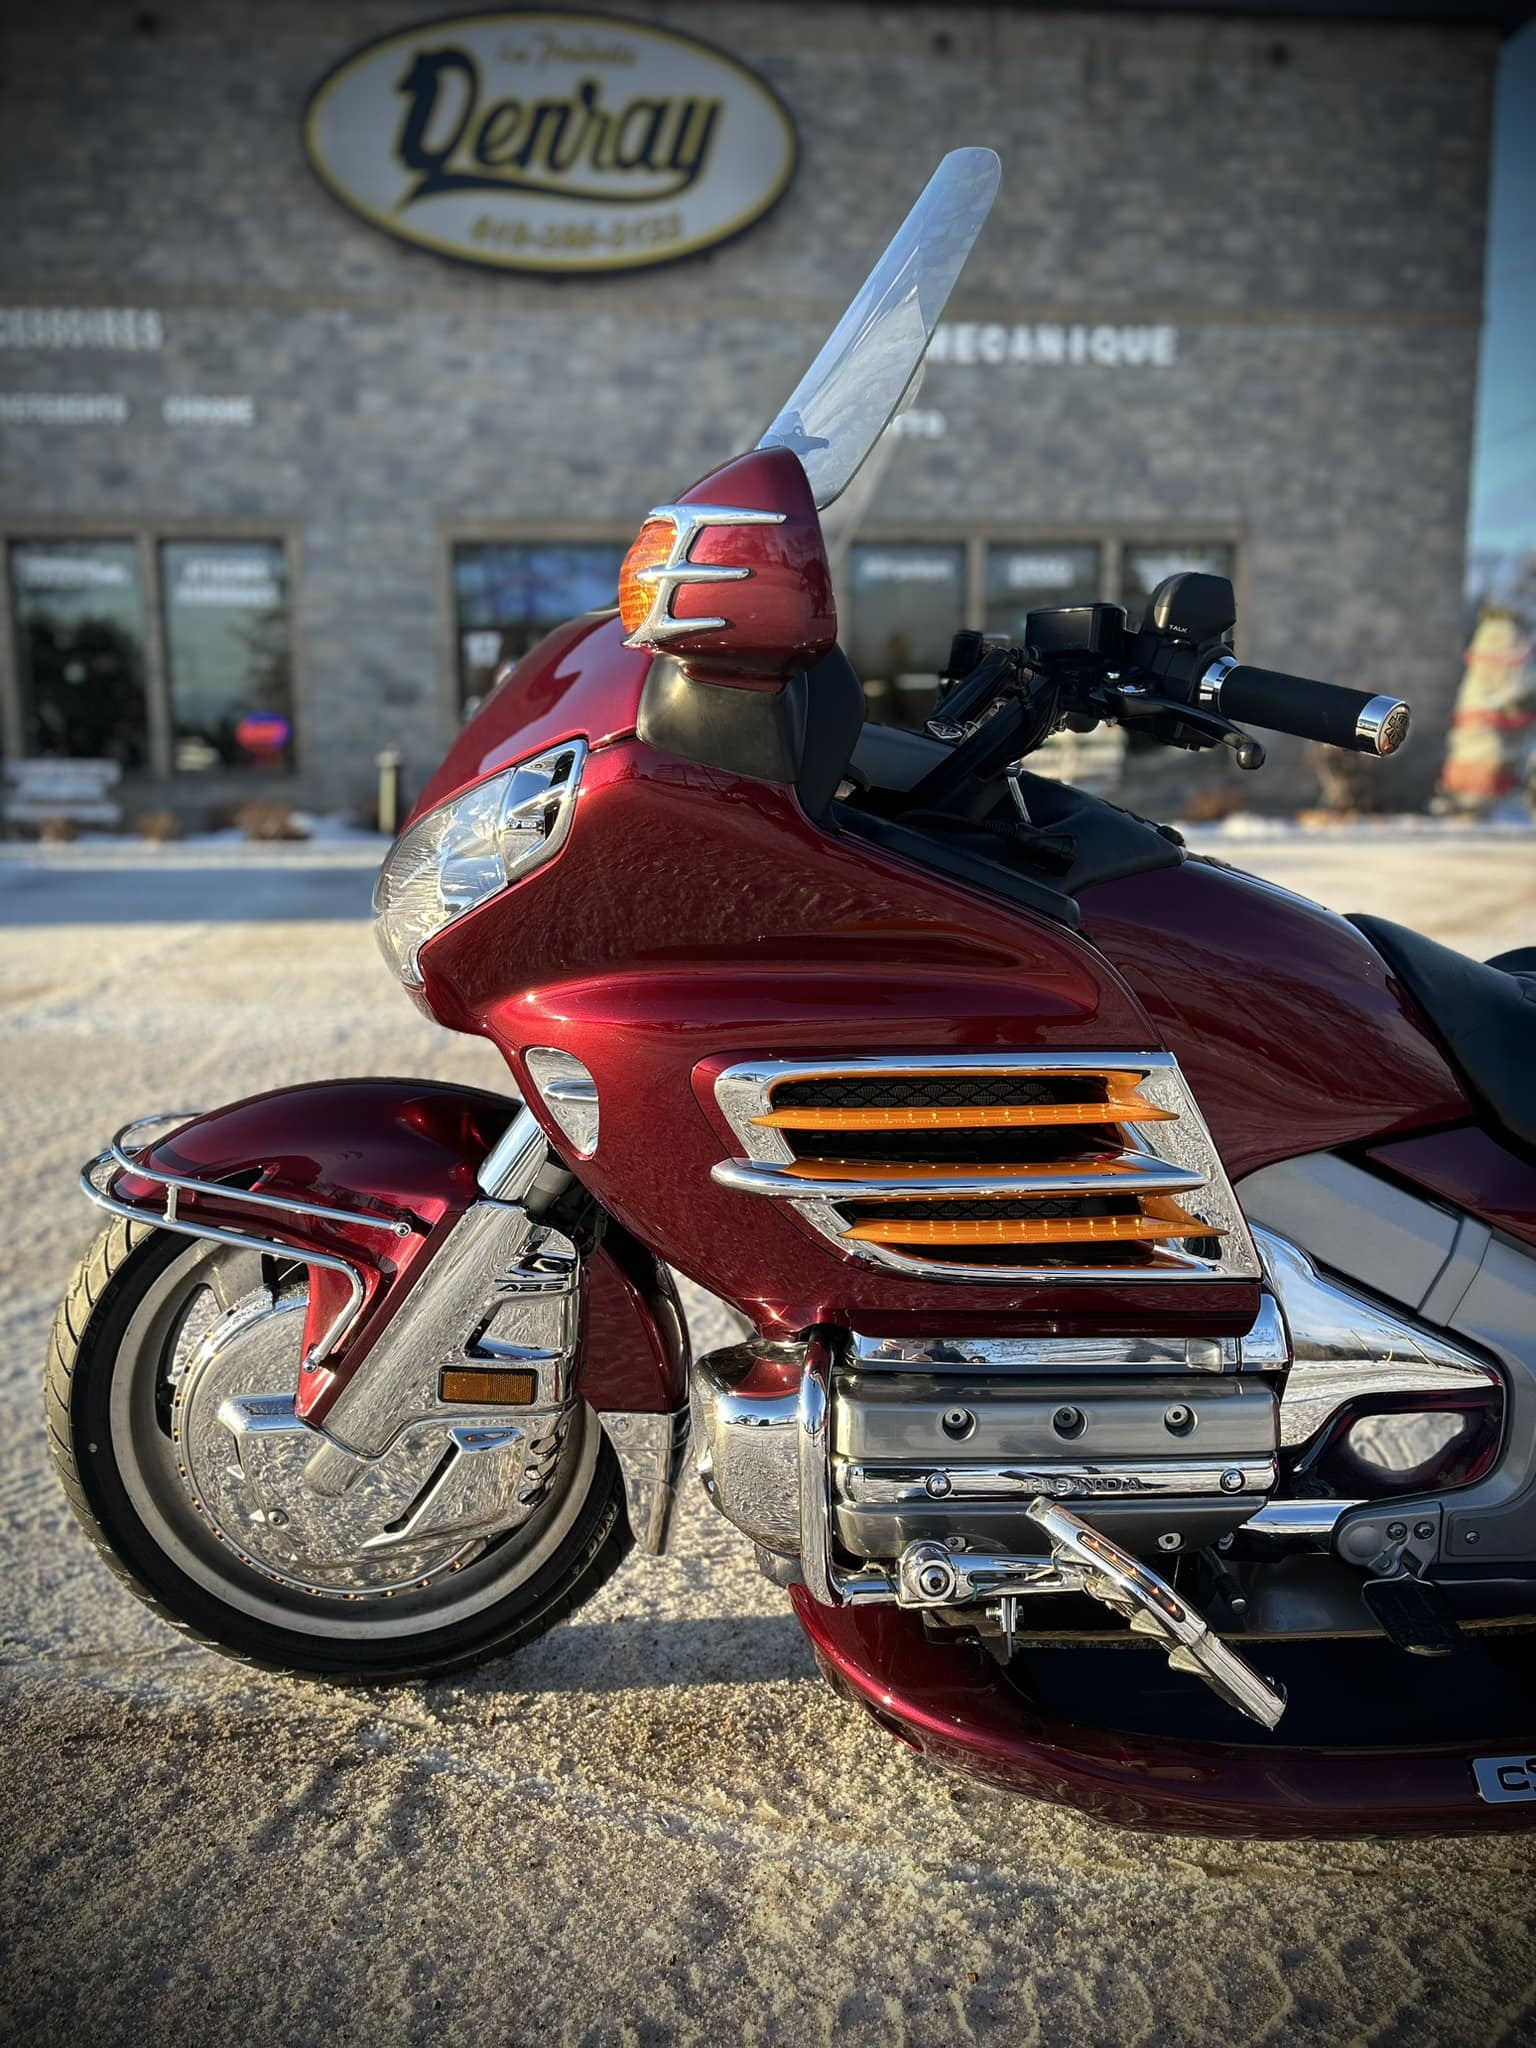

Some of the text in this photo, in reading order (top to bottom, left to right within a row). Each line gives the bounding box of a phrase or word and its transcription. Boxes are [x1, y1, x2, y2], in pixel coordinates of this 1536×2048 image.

[394, 46, 724, 205] Denray
[1169, 625, 1188, 633] TALK
[496, 1283, 564, 1293] ABS
[1024, 1477, 1148, 1493] HONDA
